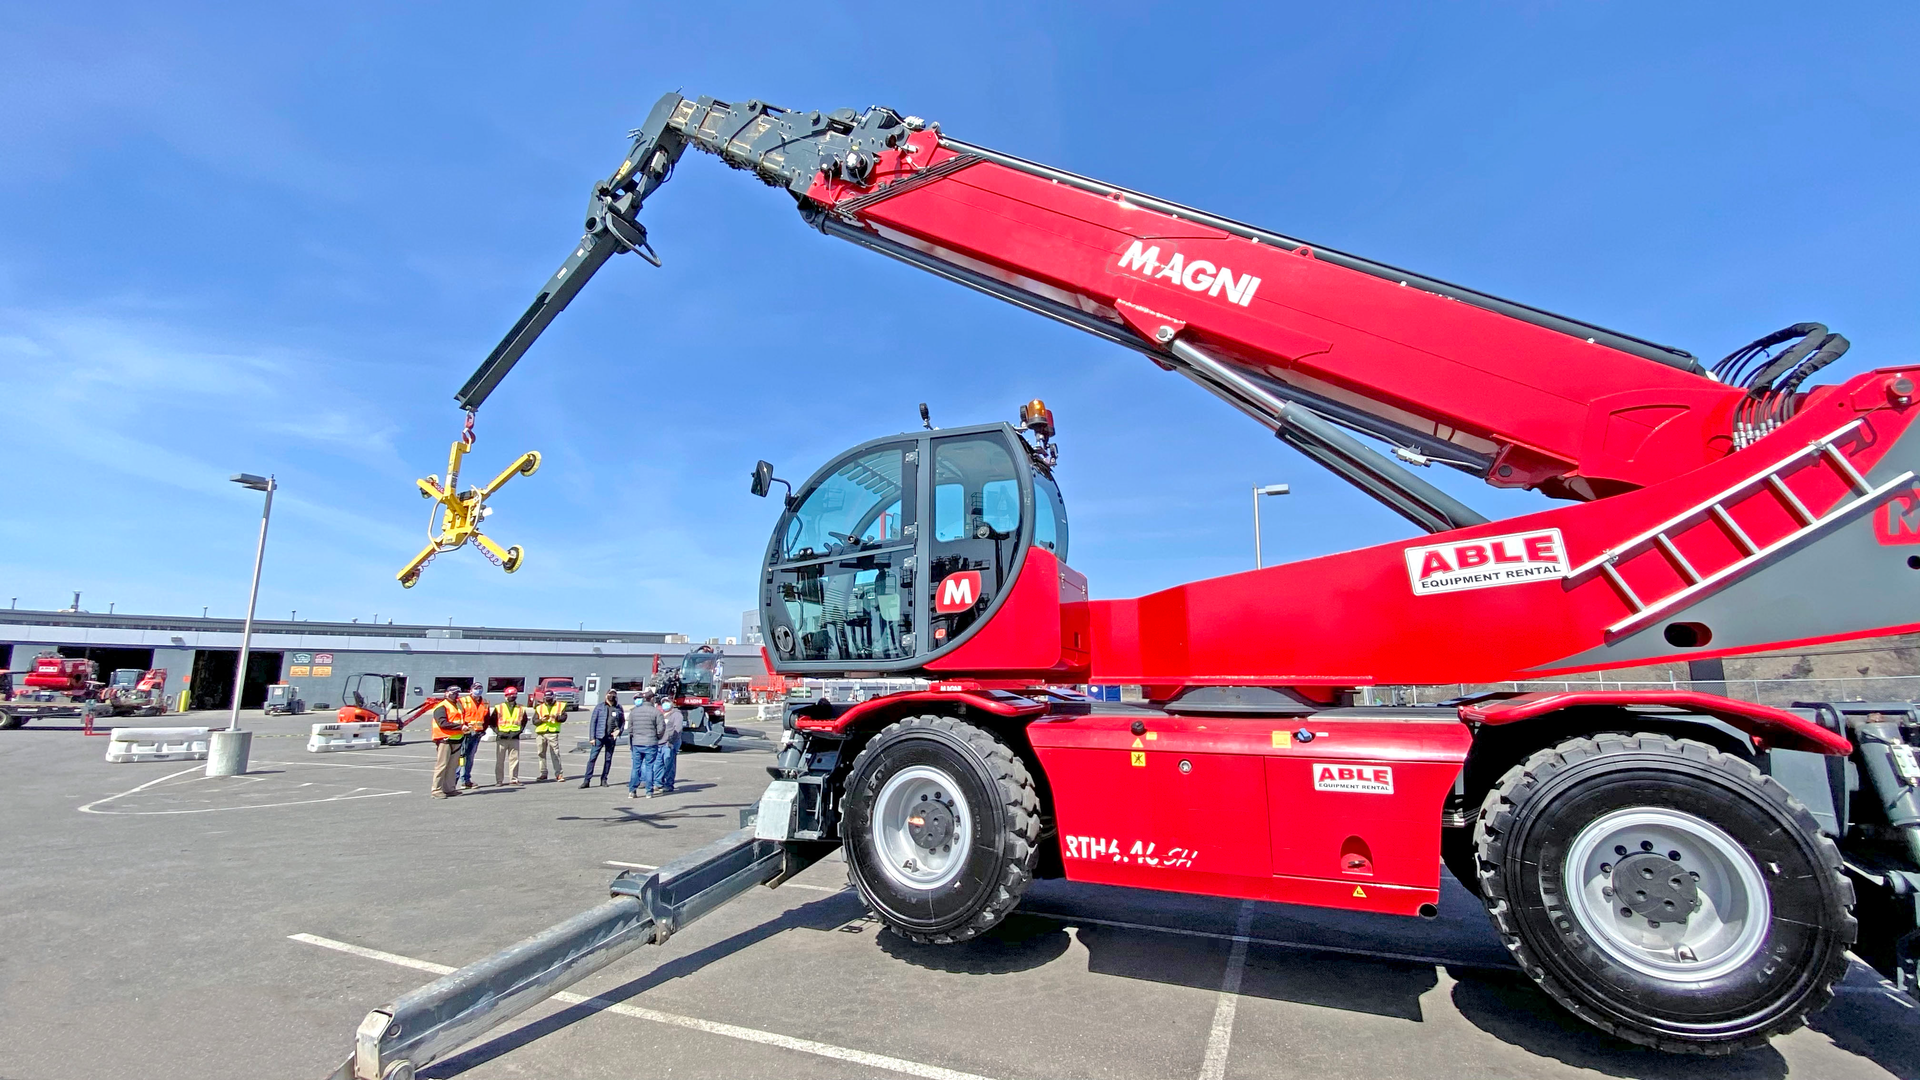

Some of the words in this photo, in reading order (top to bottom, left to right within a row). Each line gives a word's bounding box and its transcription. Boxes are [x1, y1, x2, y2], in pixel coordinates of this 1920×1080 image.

[1117, 240, 1262, 307] MAGNI
[1418, 534, 1560, 581] ABLE
[1421, 572, 1501, 589] EQUIPMENT
[1506, 565, 1561, 579] RENTAL
[943, 578, 972, 605] M
[1318, 767, 1390, 786] ABLE
